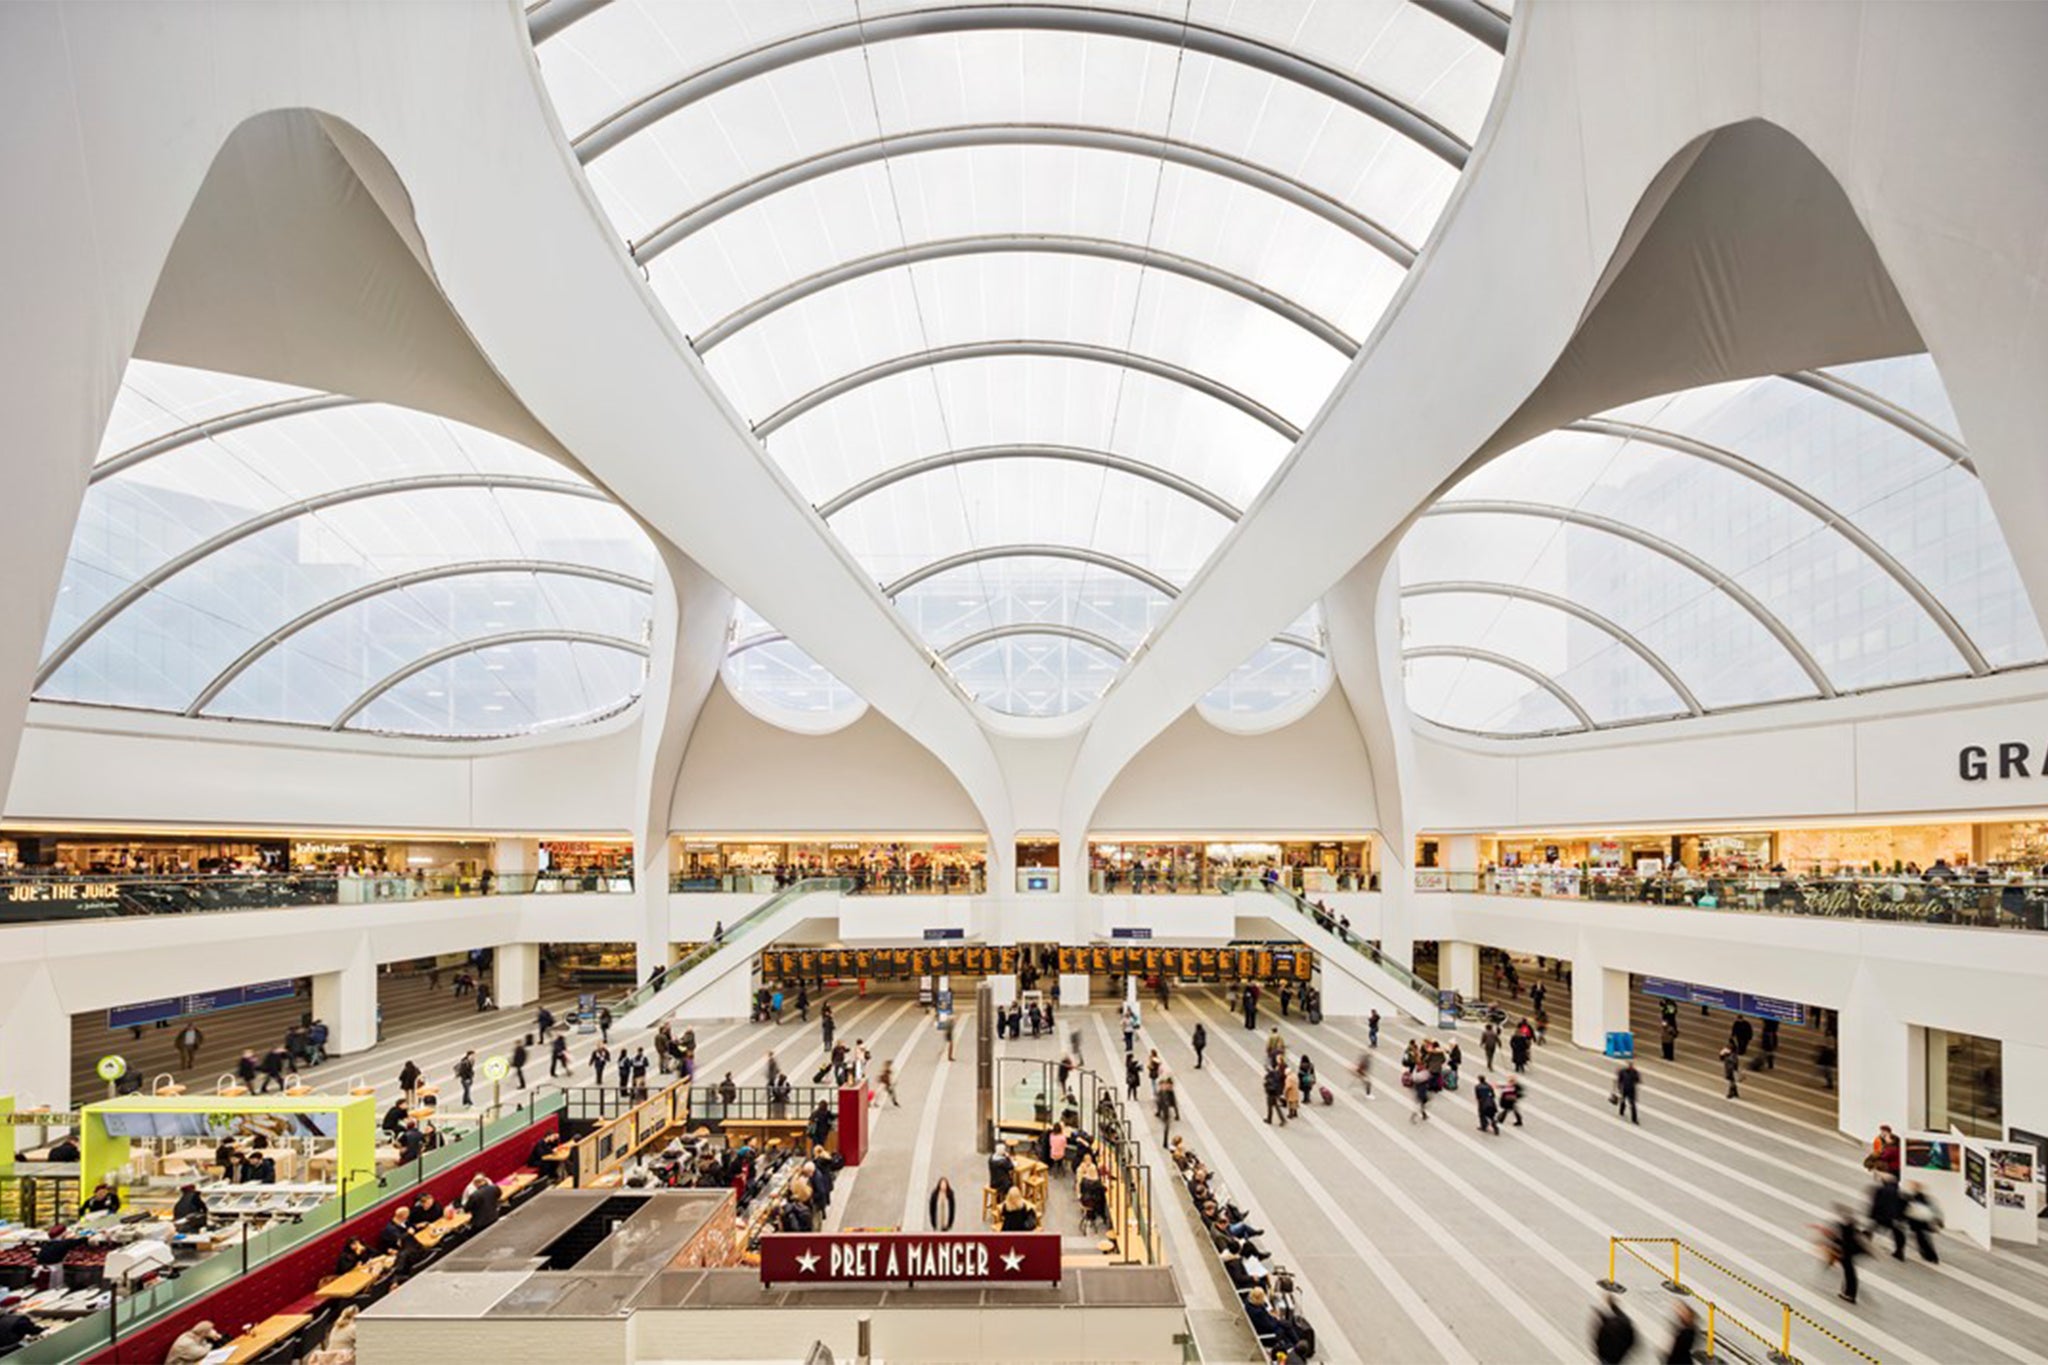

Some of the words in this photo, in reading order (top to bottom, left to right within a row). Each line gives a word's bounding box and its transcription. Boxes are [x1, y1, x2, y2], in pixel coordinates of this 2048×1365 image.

[1959, 742, 2048, 781] GR
[296, 843, 320, 853] John
[322, 843, 350, 853] Lewis
[9, 885, 39, 901] JOE
[52, 884, 79, 900] THE
[81, 883, 120, 899] JUICE
[1855, 891, 1944, 915] Concerto
[831, 1243, 880, 1277] PRET
[886, 1243, 899, 1276] A
[908, 1242, 989, 1276] MANGER
